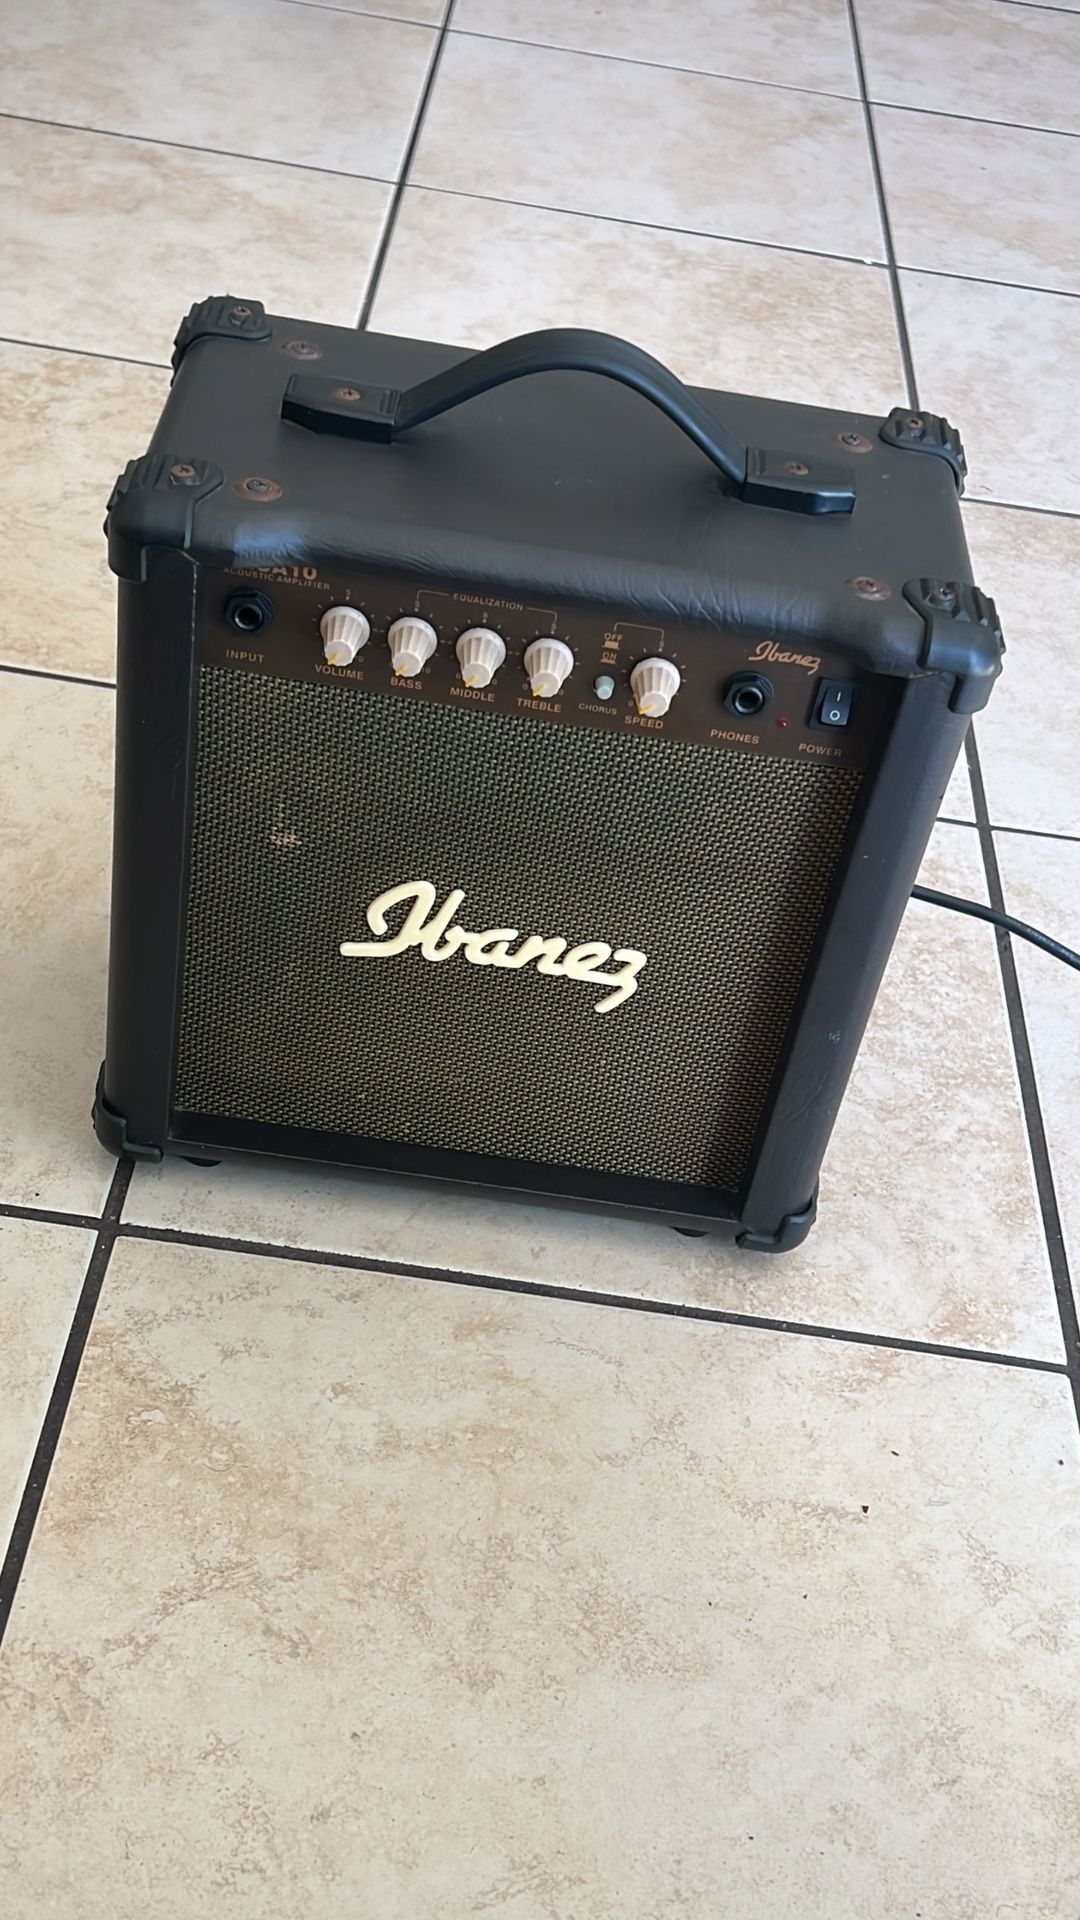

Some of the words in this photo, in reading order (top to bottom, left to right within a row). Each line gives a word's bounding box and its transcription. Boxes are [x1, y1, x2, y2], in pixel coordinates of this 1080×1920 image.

[223, 567, 274, 581] ACOUSTIC
[277, 575, 331, 591] AMPLIFIER
[453, 592, 524, 611] EQUALIZATION
[604, 632, 623, 641] OFF
[225, 649, 265, 664] INPUT
[602, 651, 618, 660] ON
[748, 640, 822, 676] Ibanez
[315, 664, 365, 681] VOLUME
[390, 676, 423, 691] BASS
[450, 687, 496, 703] MIDDLE
[517, 698, 563, 714] TREBLE
[578, 702, 618, 716] CHORUS
[624, 715, 665, 730] SPEED
[710, 728, 760, 745] PHONES
[798, 742, 843, 758] POWER
[340, 880, 648, 1014] Ibanez
